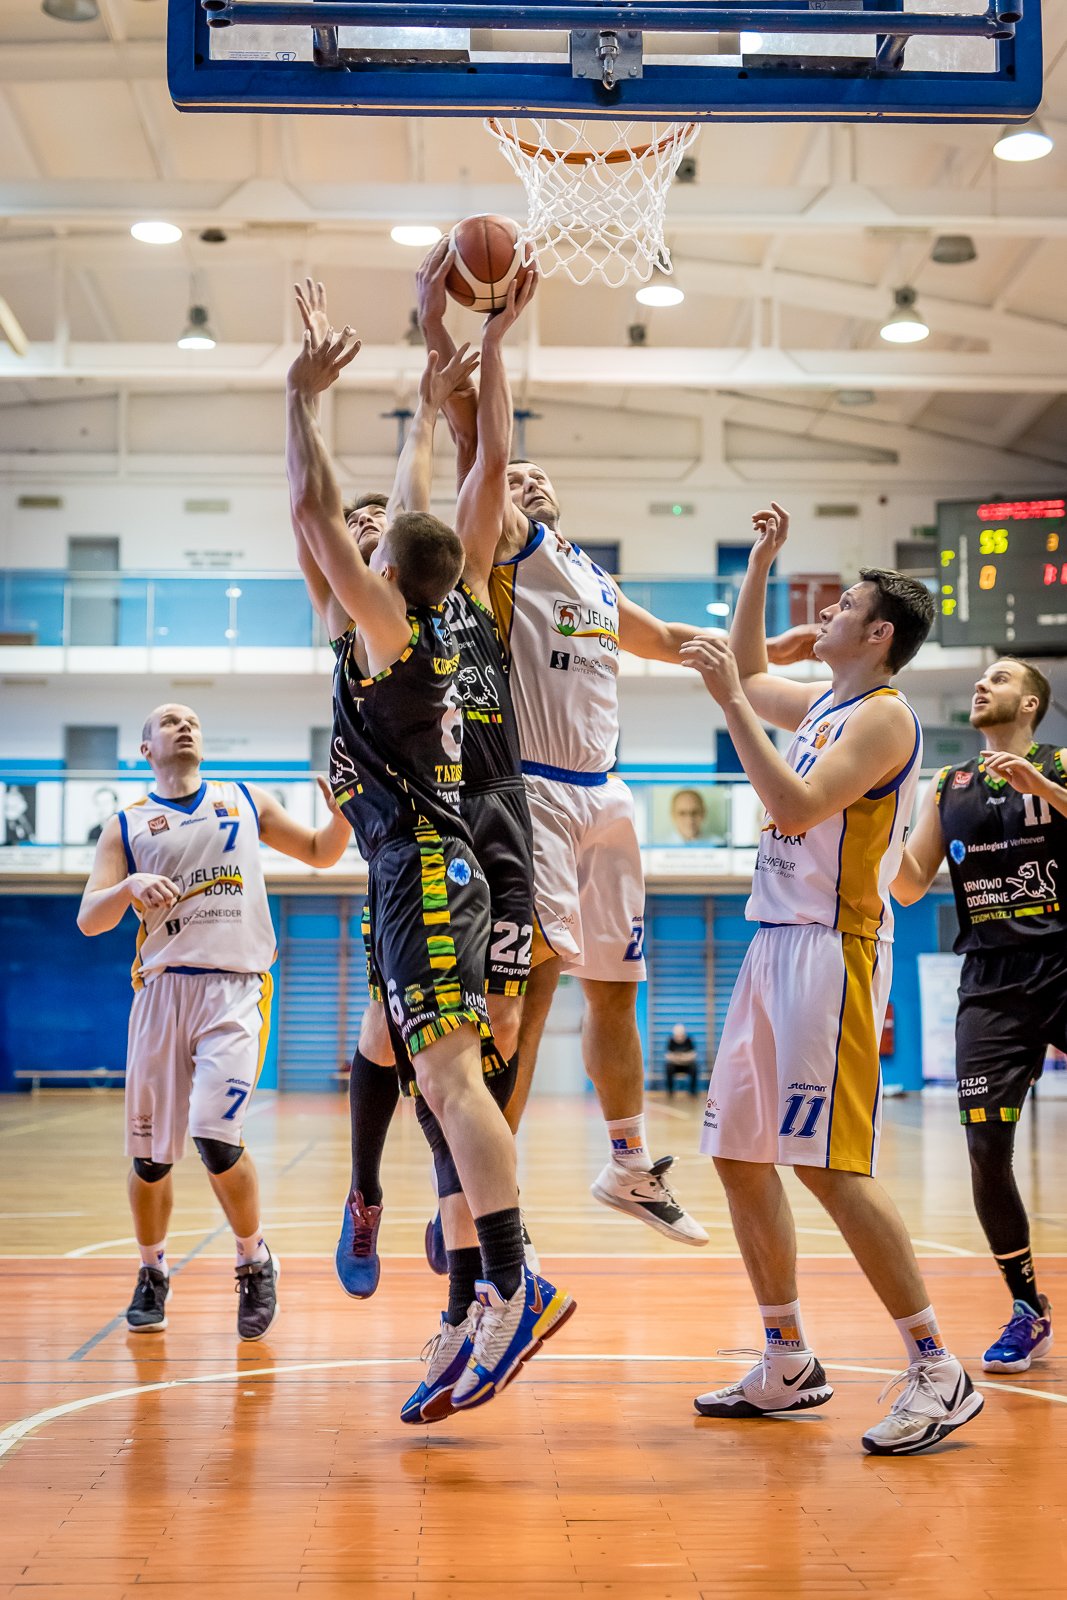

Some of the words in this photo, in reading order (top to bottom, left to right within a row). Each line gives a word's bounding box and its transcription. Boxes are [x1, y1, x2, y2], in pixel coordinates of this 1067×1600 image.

[979, 528, 1009, 555] 55
[1022, 793, 1052, 827] 11
[219, 821, 240, 854] 7
[189, 864, 242, 887] JELENIA
[490, 920, 533, 966] 22
[788, 1081, 828, 1092] stelman
[961, 1076, 988, 1088] FIZJO
[961, 1085, 989, 1098] TOUCH
[221, 1086, 248, 1121] 7
[778, 1093, 827, 1139] 11
[767, 1339, 801, 1348] SUDETY
